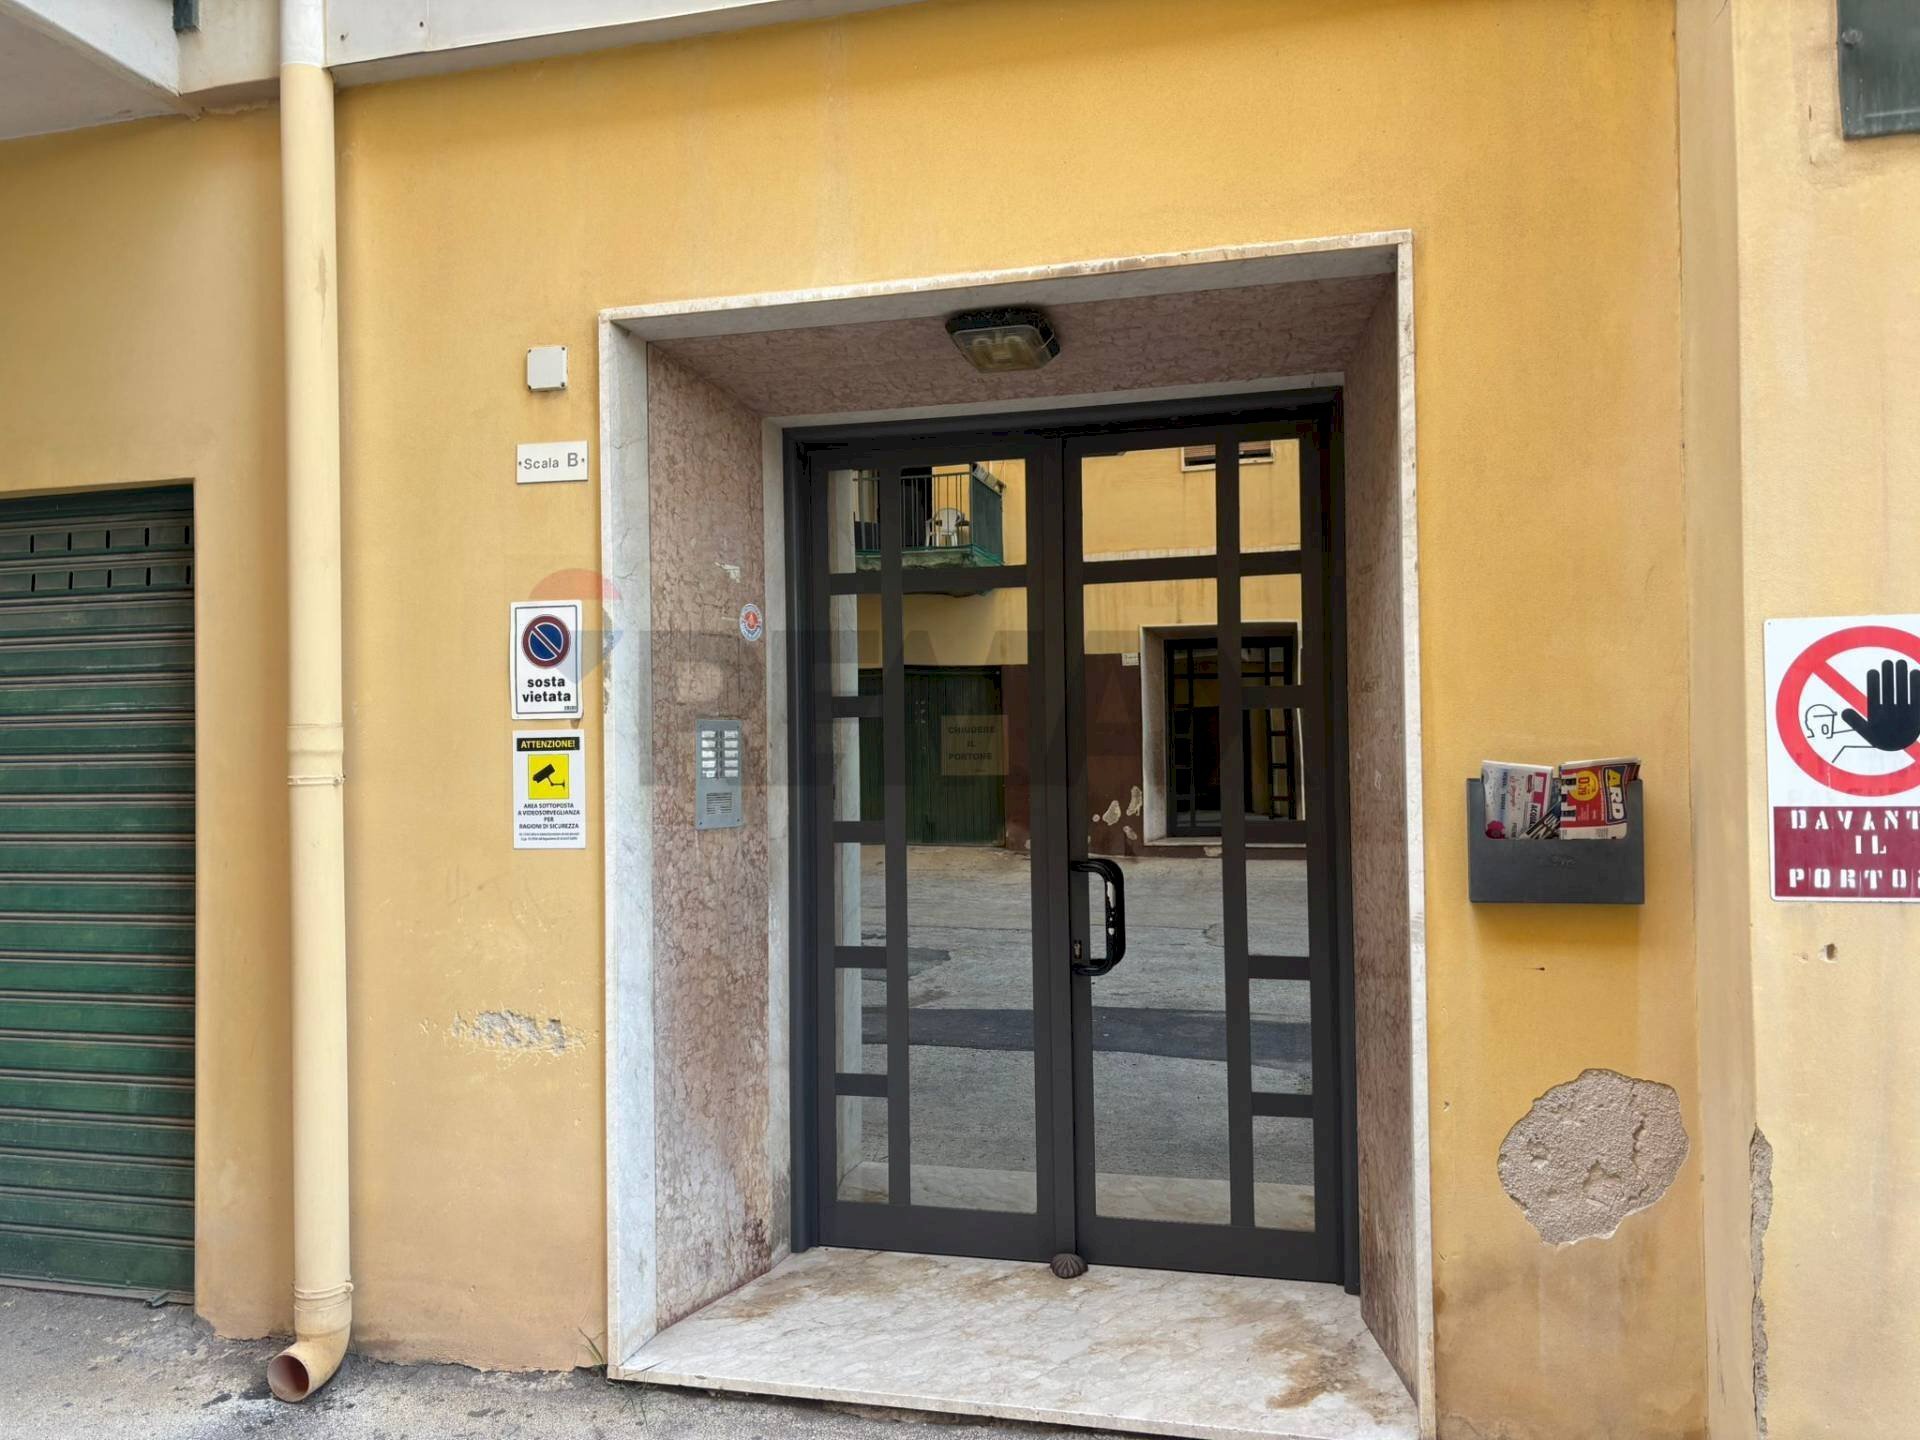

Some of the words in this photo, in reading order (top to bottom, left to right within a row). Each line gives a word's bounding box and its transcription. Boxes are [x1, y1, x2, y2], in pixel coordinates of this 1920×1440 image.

[523, 457, 560, 470] Scala
[567, 452, 579, 467] B
[527, 676, 566, 688] sosta
[522, 690, 572, 703] vietata
[520, 739, 576, 749] ATTENZIONE!
[948, 752, 993, 761] PORTONE
[1855, 834, 1887, 855] IL
[1789, 868, 1920, 890] PORTO
